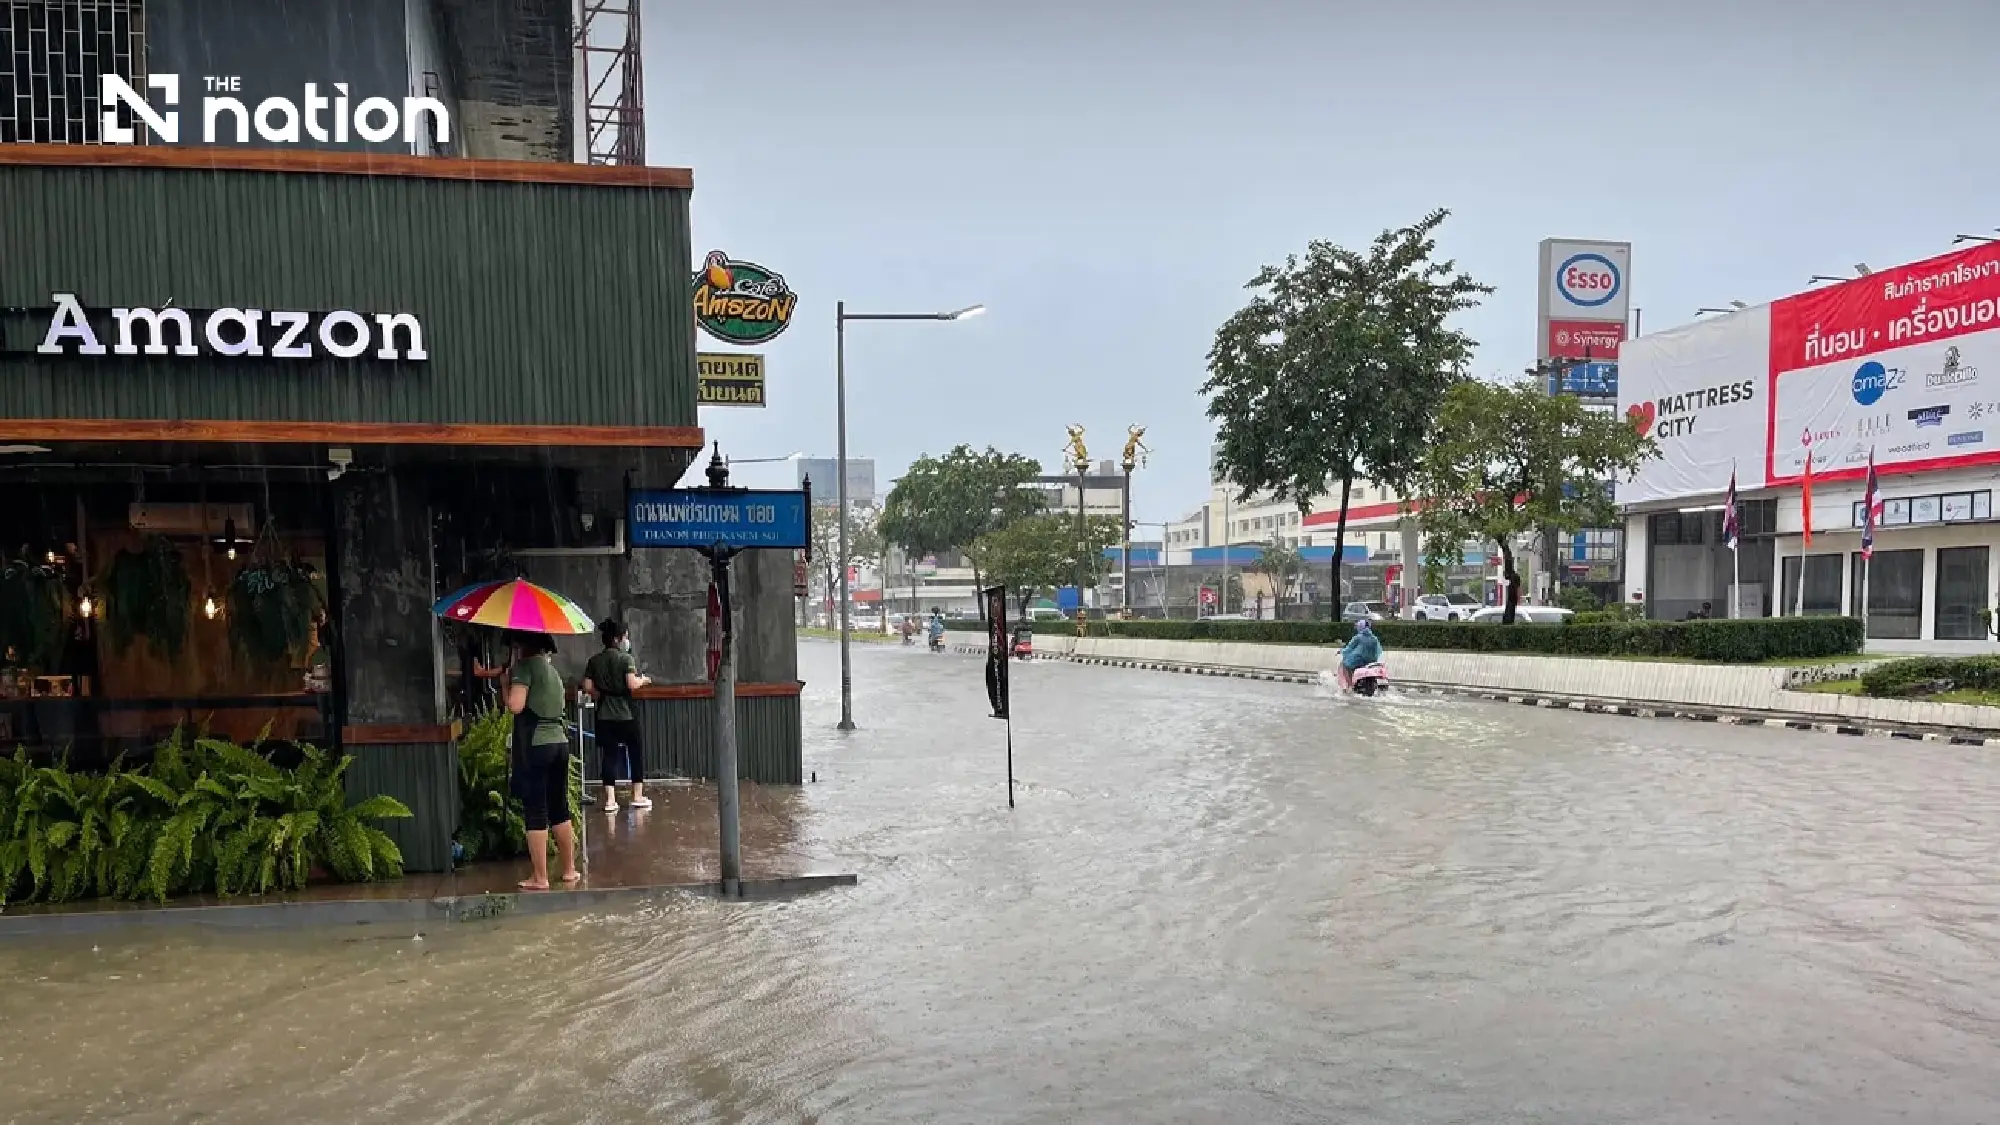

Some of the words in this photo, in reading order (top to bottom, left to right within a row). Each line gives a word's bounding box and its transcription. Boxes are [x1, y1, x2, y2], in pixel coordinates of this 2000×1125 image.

[1566, 266, 1612, 290] Esso
[37, 292, 428, 360] Amazon
[1804, 323, 1865, 361] ที่นอน
[1888, 296, 2000, 341] เครื่องนอ
[1573, 331, 1619, 349] Synergy
[1657, 379, 1754, 417] MATTRESS
[1657, 416, 1697, 439] CITY
[745, 503, 775, 524] ซอย
[789, 504, 800, 524] 7
